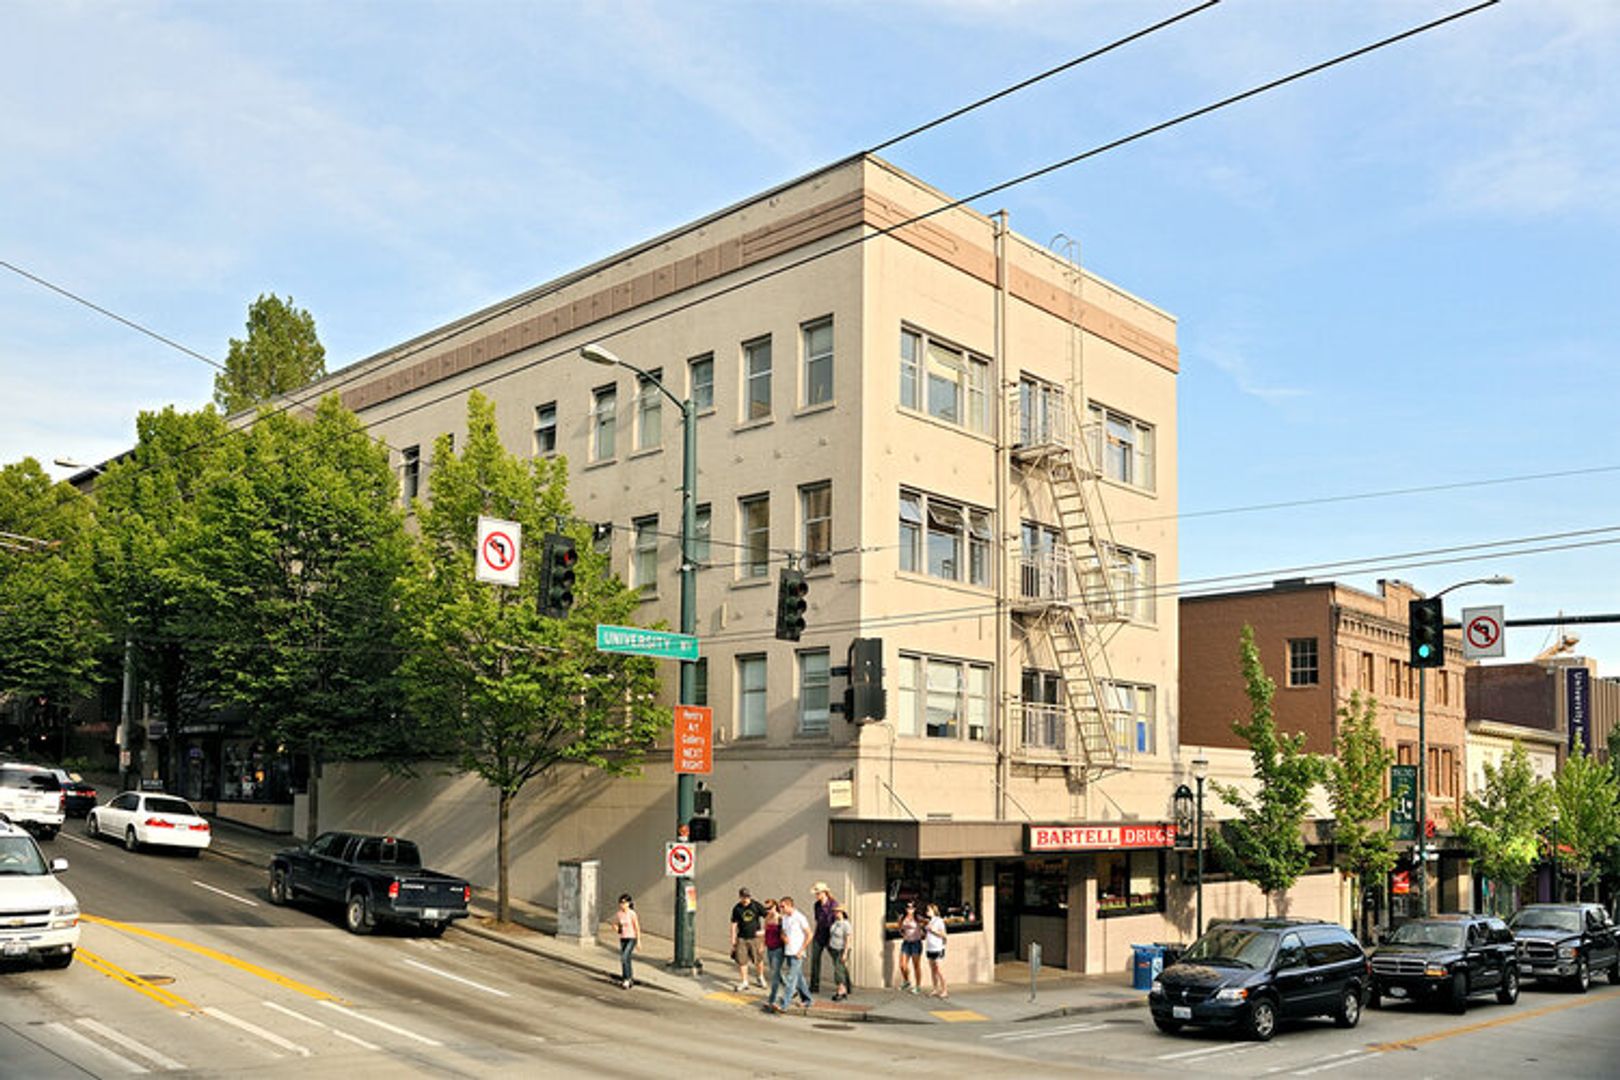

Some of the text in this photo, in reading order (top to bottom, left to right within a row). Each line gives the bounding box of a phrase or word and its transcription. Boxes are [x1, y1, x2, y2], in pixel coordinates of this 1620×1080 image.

[603, 630, 671, 652] UNIVERSITY
[1573, 671, 1584, 724] University
[682, 709, 704, 723] Henry
[682, 747, 704, 758] NEXT
[682, 759, 704, 770] RIGHT
[1036, 829, 1118, 845] BARTELL
